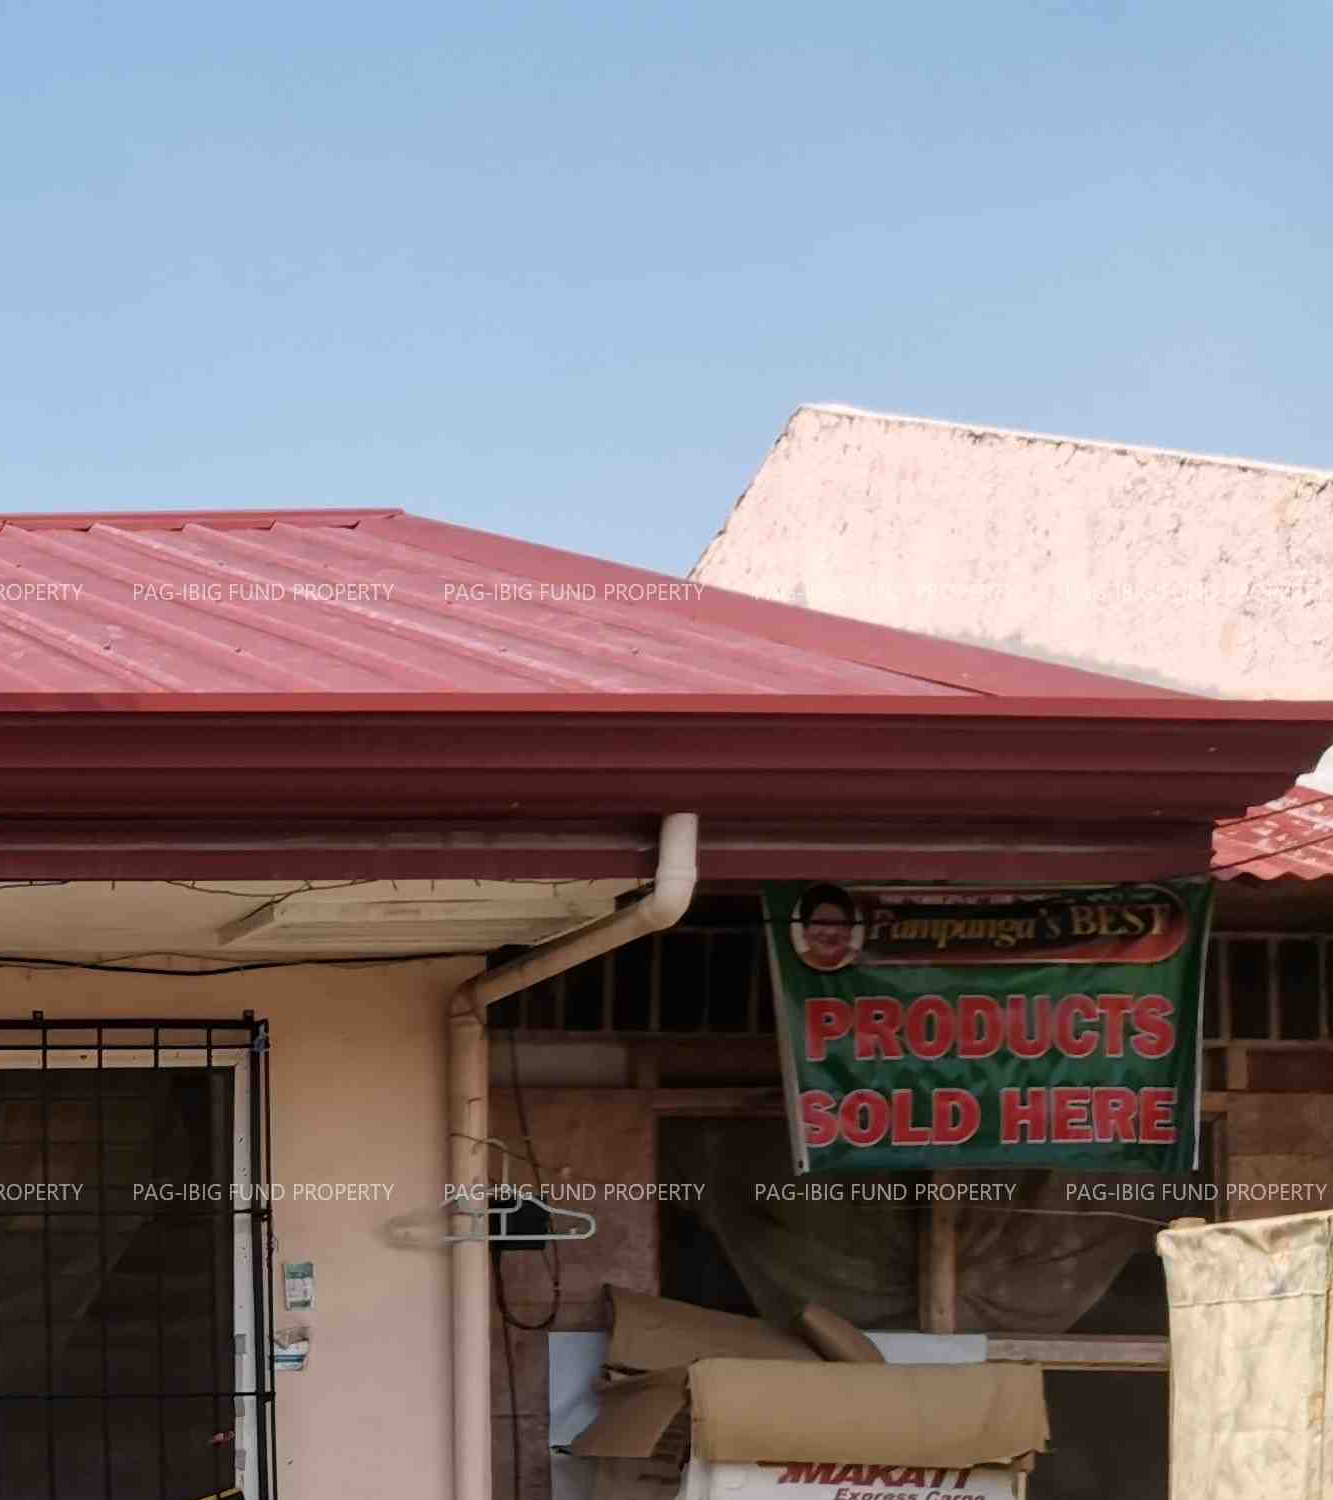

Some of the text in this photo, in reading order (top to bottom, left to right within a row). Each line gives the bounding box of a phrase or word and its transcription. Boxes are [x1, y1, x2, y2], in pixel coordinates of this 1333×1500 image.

[1068, 903, 1170, 937] BEST
[805, 993, 1176, 1063] PRODUCTS
[799, 1086, 1178, 1147] SOLD HERE
